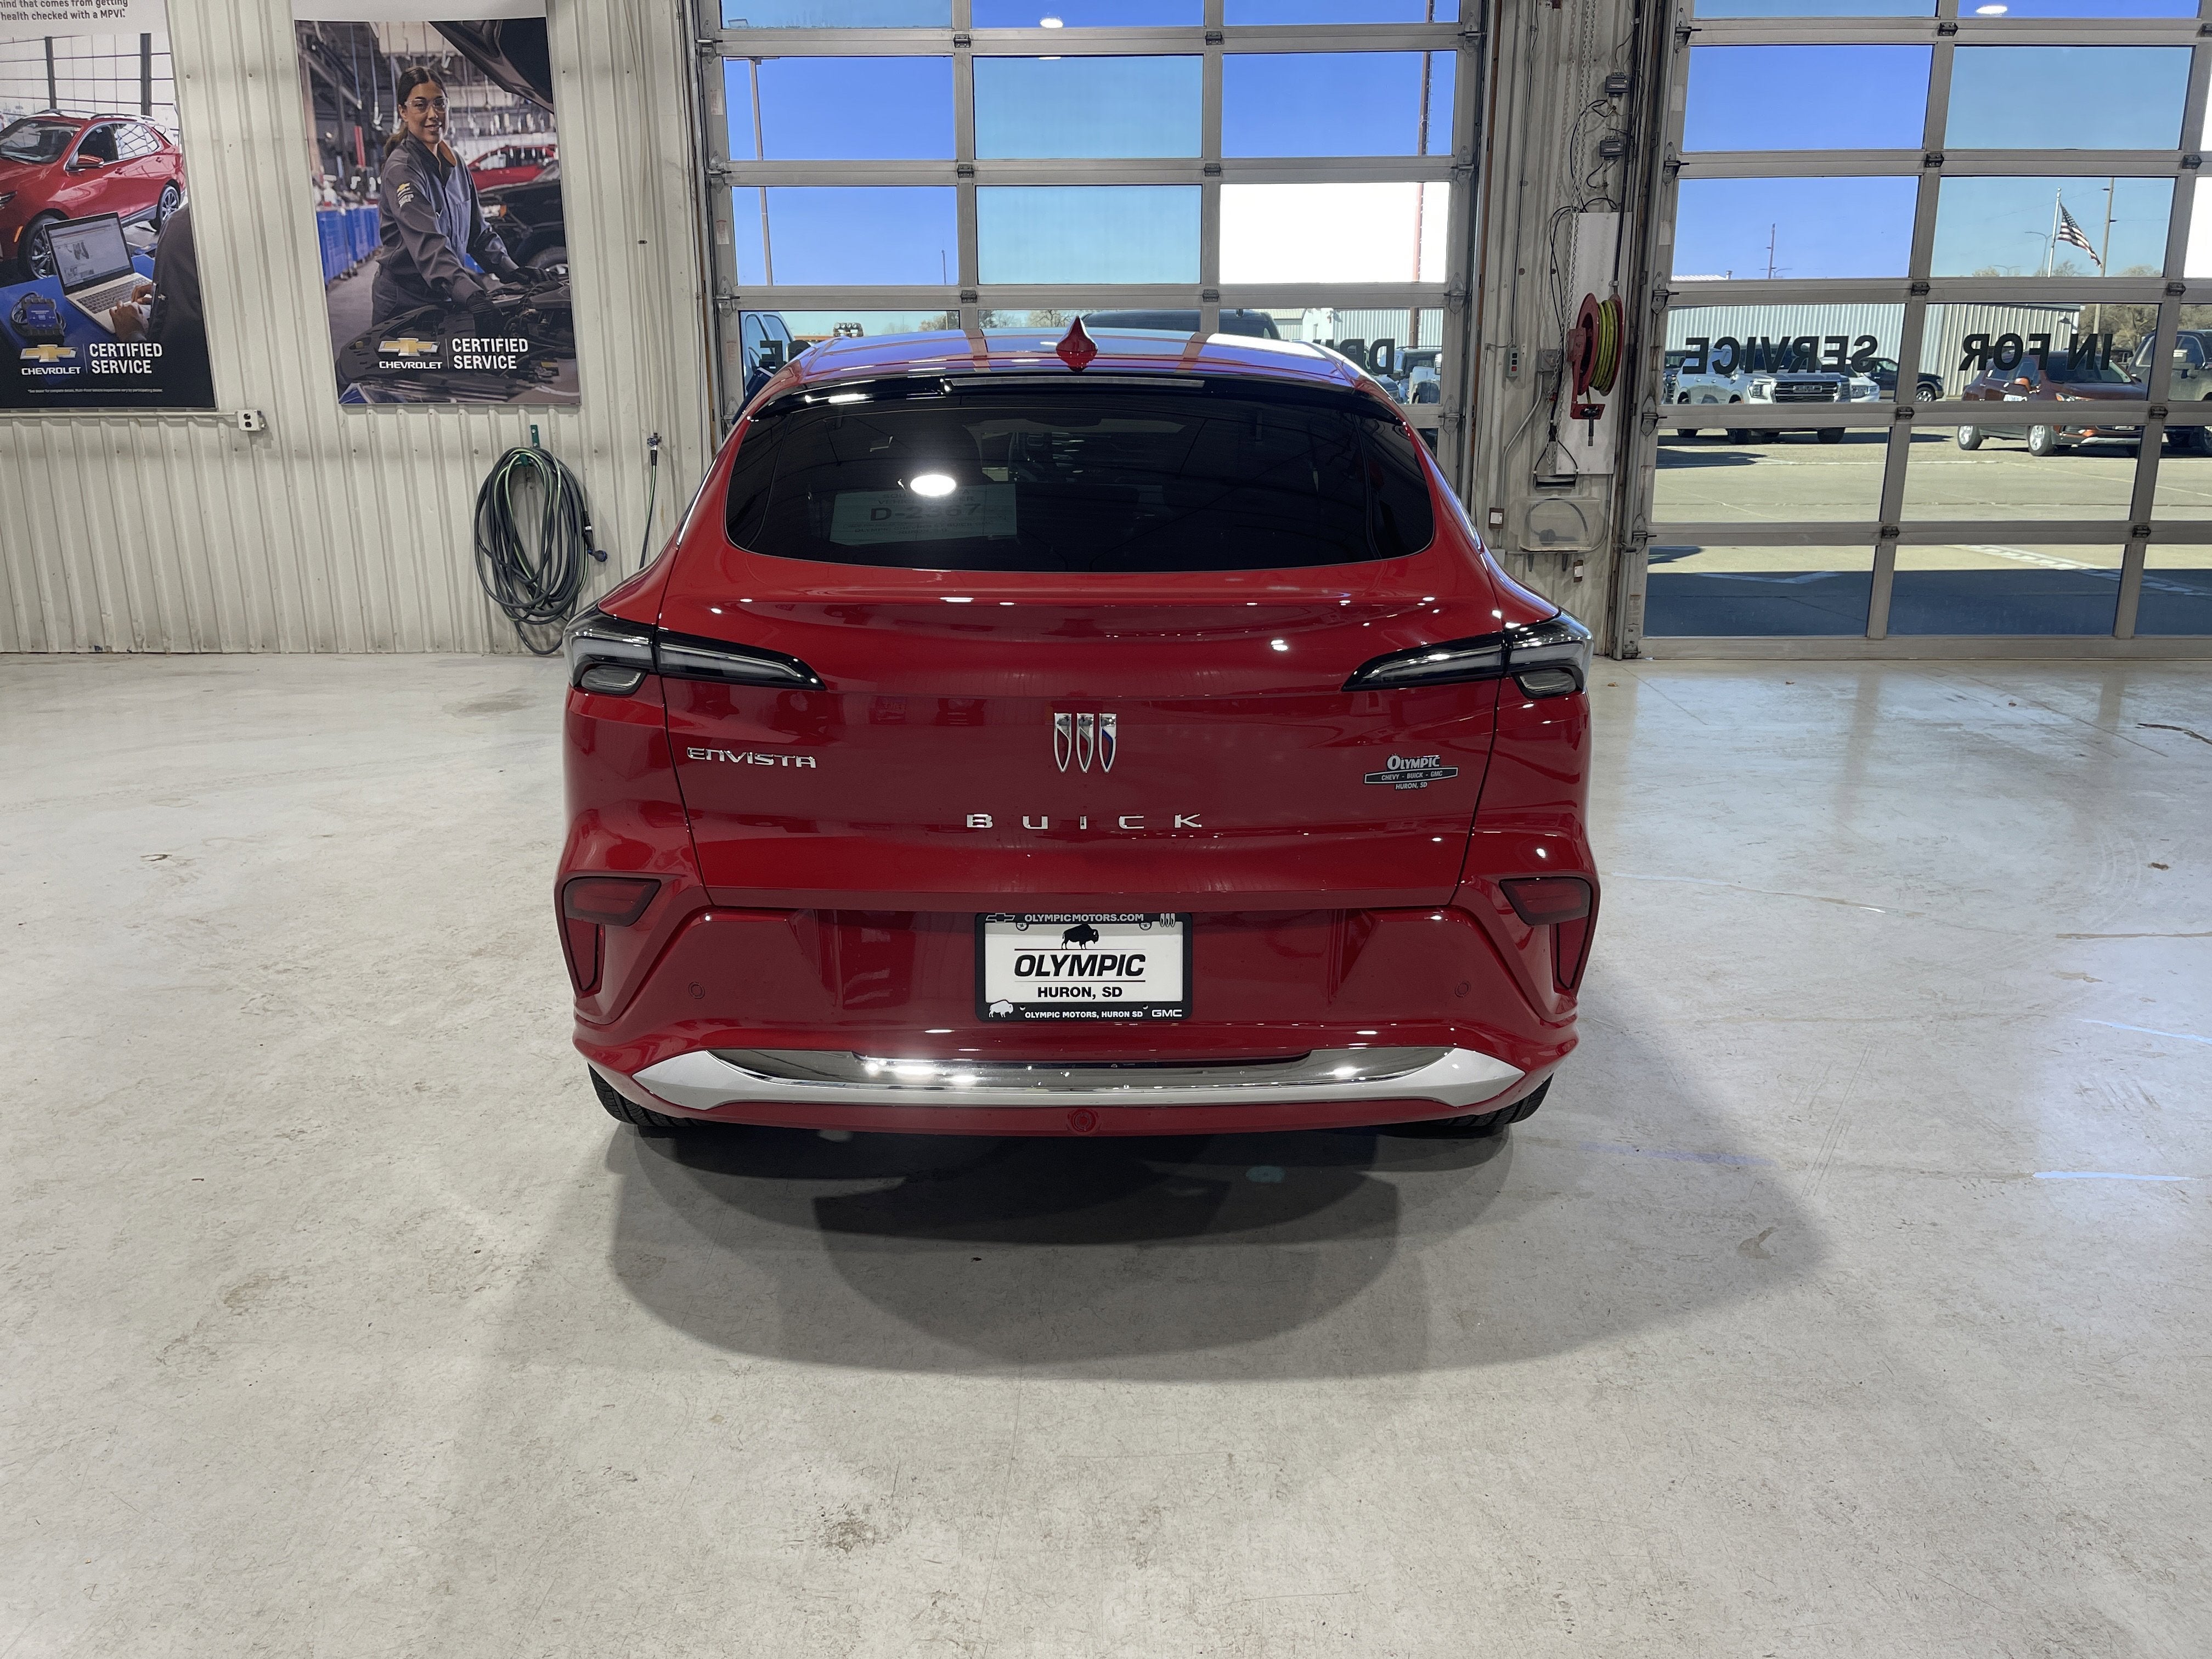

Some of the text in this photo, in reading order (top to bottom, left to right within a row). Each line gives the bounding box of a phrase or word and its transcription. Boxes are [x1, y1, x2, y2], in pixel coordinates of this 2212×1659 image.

[96, 0, 128, 8] getting
[1, 12, 29, 20] health
[32, 11, 68, 20] checked
[70, 10, 90, 19] with
[89, 343, 163, 357] CERTIFIED
[452, 338, 528, 352] CERTIFIED
[91, 359, 153, 374] SERVICE
[379, 361, 443, 369] CHEVROLET
[454, 355, 517, 369] SERVICE
[21, 366, 81, 375] CHEVROLET
[687, 747, 816, 768] ENVISTA
[967, 814, 1202, 830] BUICK
[1024, 913, 1144, 922] OLYMPICMOTORS.COM
[1014, 953, 1146, 977] OLYMPIC
[1037, 986, 1122, 1000] HURON, SD
[1062, 1011, 1099, 1019] MOTORS,
[1152, 1009, 1182, 1017] GMC
